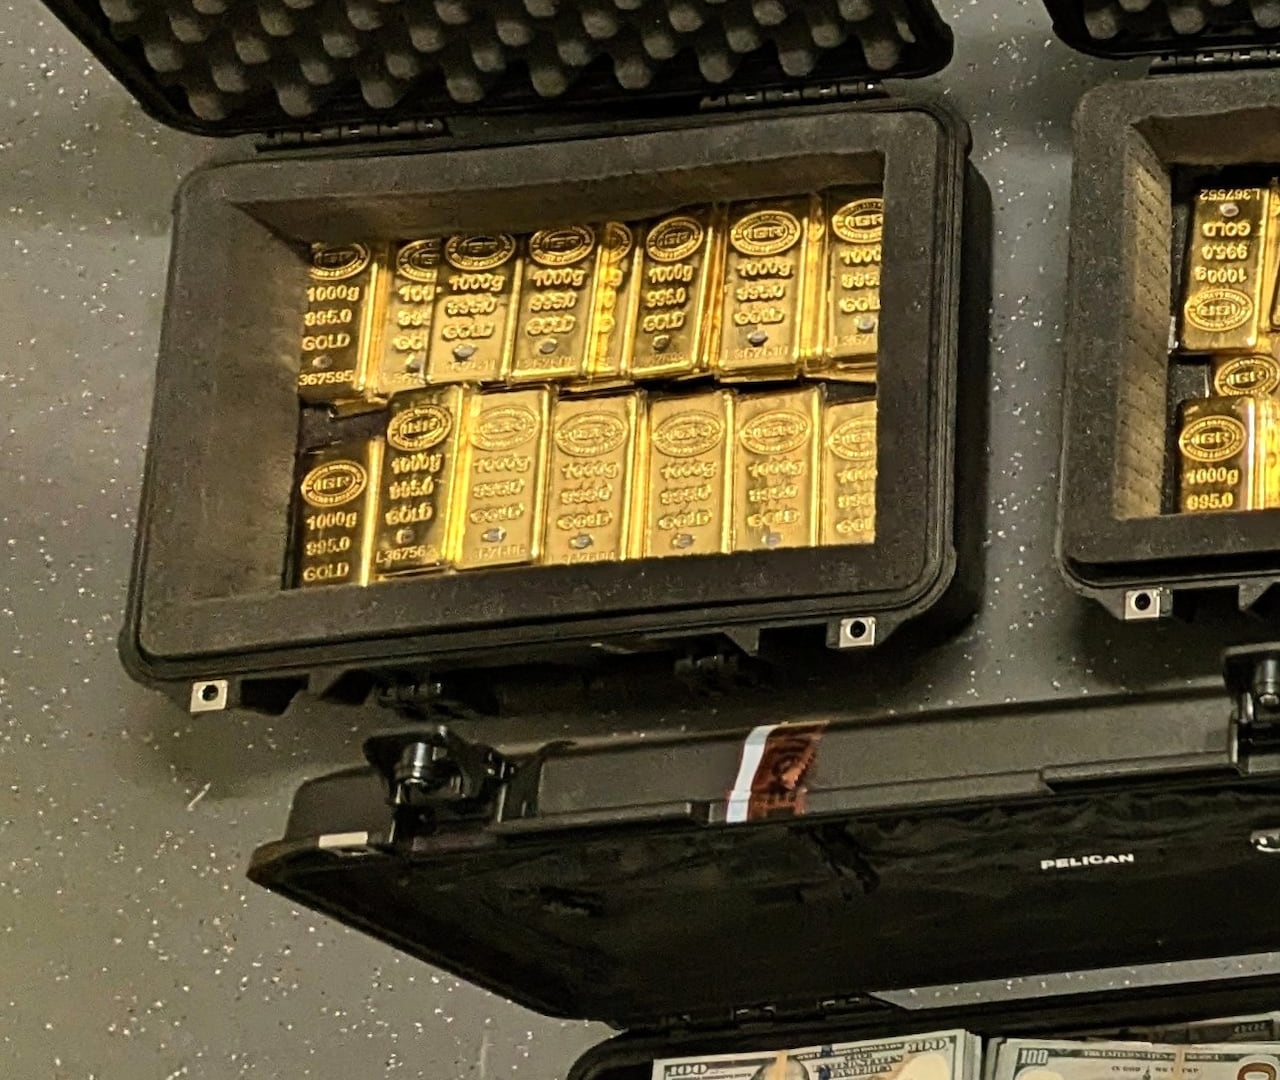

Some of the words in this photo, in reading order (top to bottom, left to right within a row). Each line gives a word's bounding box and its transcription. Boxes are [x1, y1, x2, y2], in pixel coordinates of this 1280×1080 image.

[1201, 188, 1261, 200] L367552
[748, 227, 784, 239] IGR
[1203, 222, 1251, 237] GOLD
[840, 246, 881, 264] 1000
[1202, 245, 1247, 260] 995.0
[533, 268, 586, 287] 1000g
[649, 265, 693, 283] 1000g
[738, 261, 793, 277] 1000g
[1196, 267, 1247, 283] 1000g
[449, 274, 504, 291] 1000g
[307, 285, 360, 302] 1000g
[646, 287, 686, 308] 995.0
[839, 296, 881, 312] GOL
[305, 309, 353, 326] 995.0
[643, 312, 685, 332] GOLD
[733, 307, 785, 325] GOLD
[442, 321, 495, 338] GOLD
[527, 315, 576, 335] GOLD
[302, 334, 350, 351] GOLD
[299, 371, 353, 386] 367595
[1191, 431, 1233, 445] IGR
[391, 454, 442, 474] 1000g
[1188, 468, 1239, 485] 1000g
[1187, 492, 1233, 510] 995.0
[307, 512, 357, 529] 1000g
[385, 502, 432, 525] GOLD
[306, 538, 350, 555] 995.0
[303, 563, 349, 580] GOLD
[1040, 853, 1134, 869] PELICAN
[1019, 1048, 1049, 1065] 100
